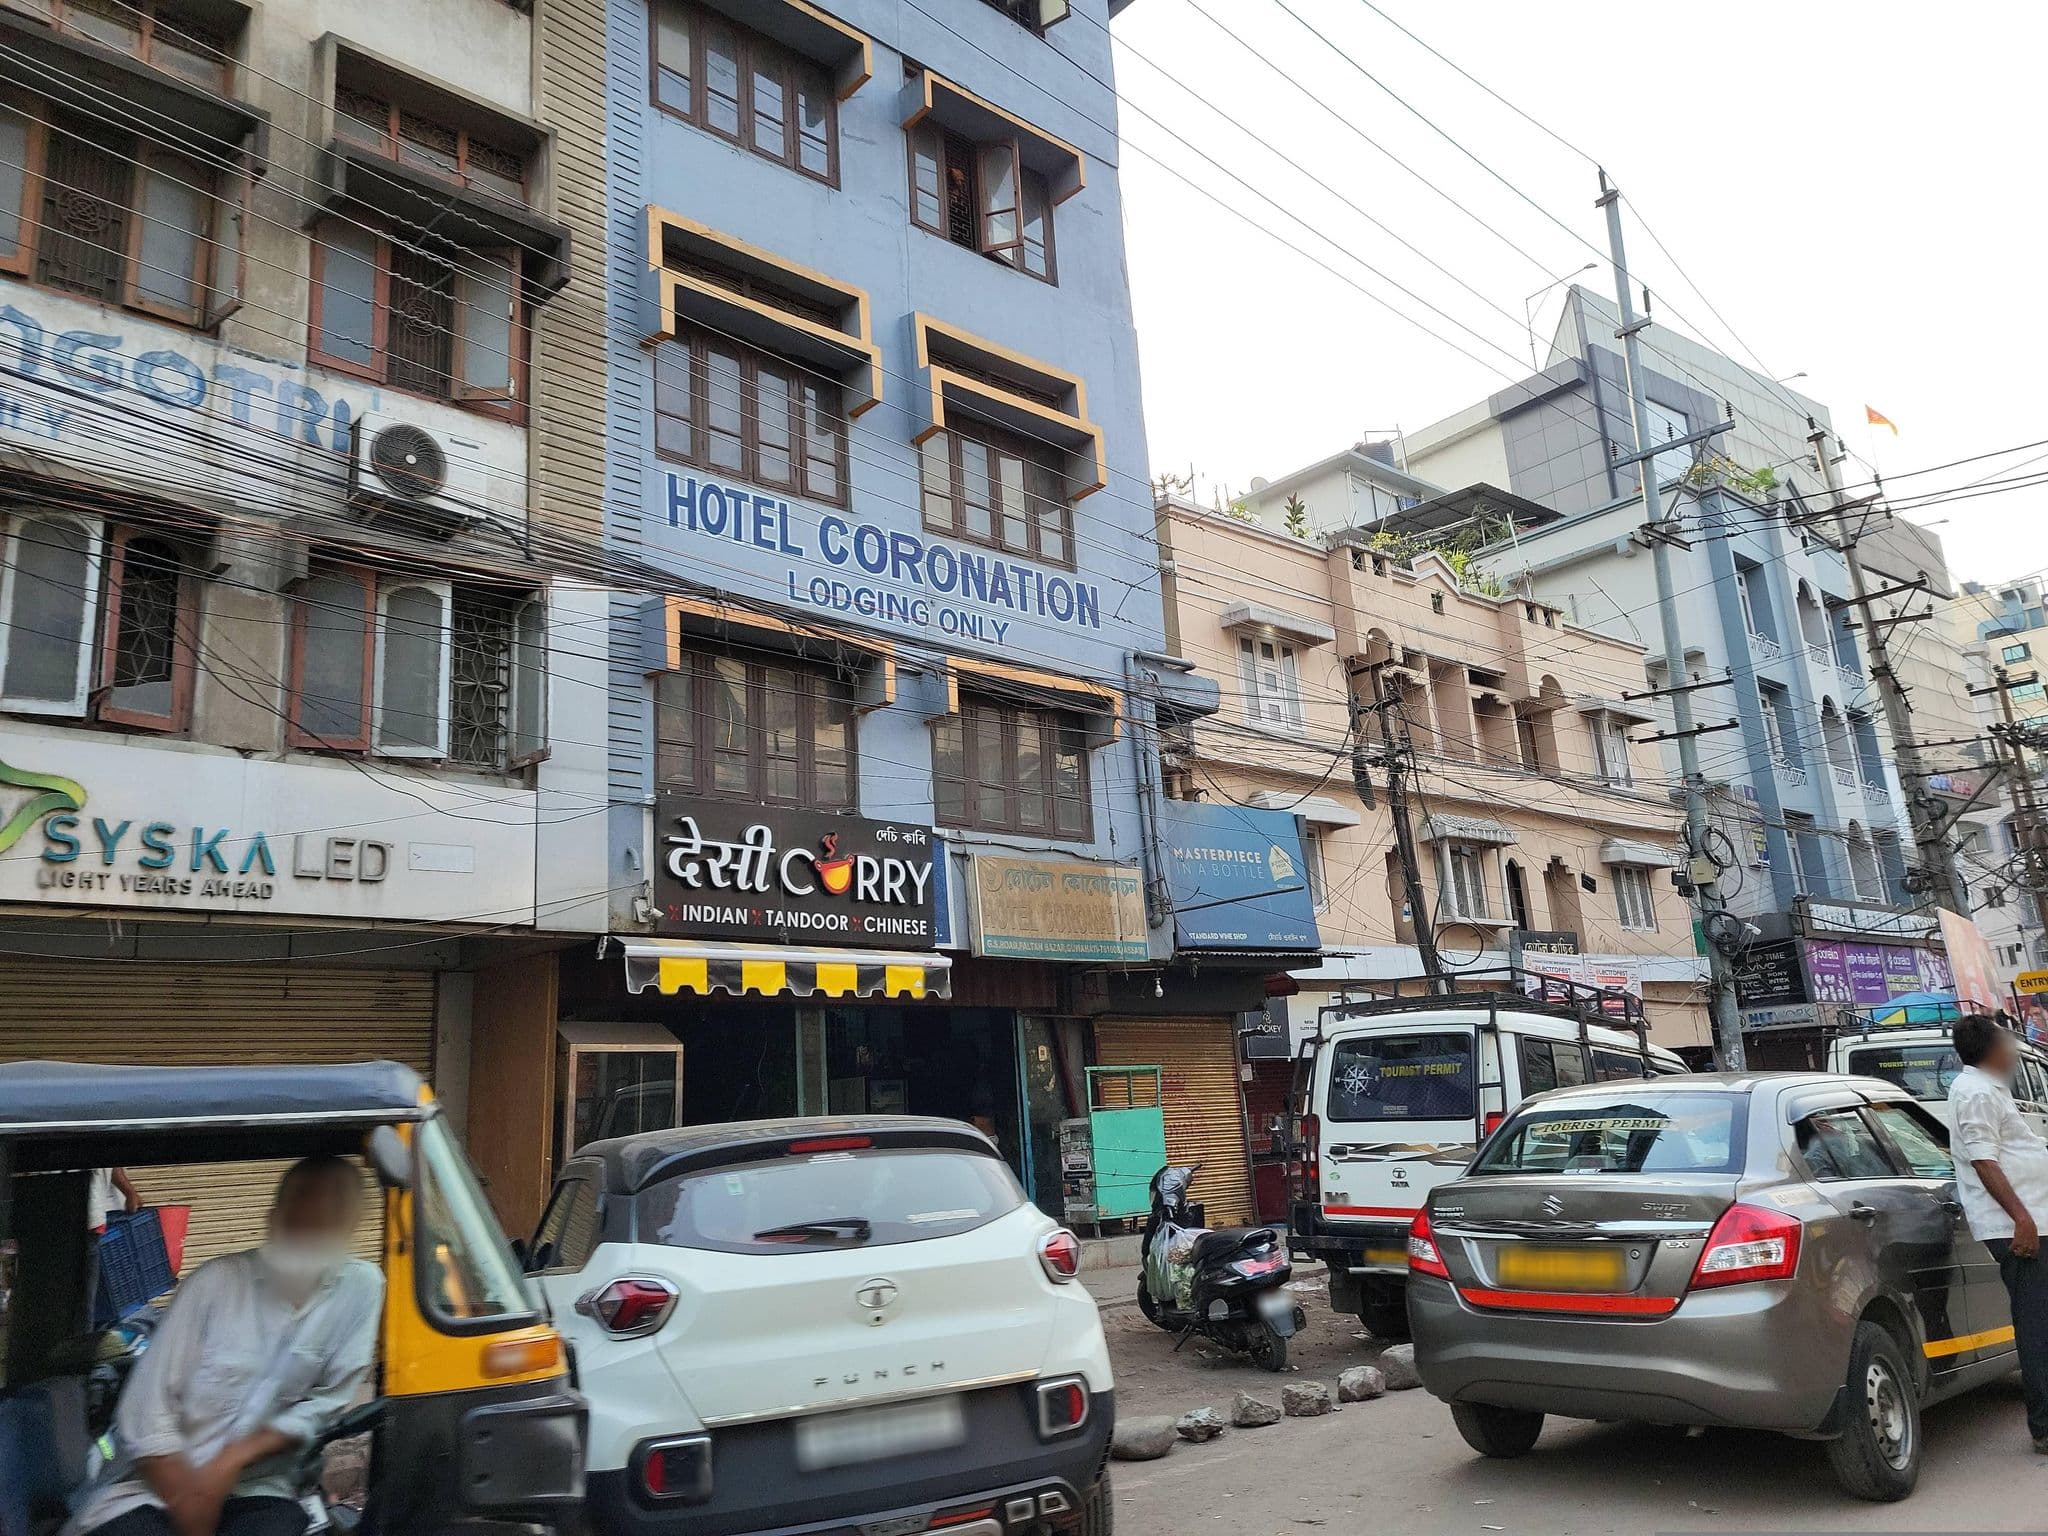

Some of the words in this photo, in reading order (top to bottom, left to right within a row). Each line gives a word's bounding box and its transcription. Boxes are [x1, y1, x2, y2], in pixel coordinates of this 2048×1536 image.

[666, 472, 804, 557] HOTEL
[818, 515, 1102, 630] CORONATION
[788, 569, 930, 628] LODGING
[938, 606, 1010, 646] ONLY
[294, 834, 392, 882] LED
[664, 815, 776, 893] देसी
[1173, 847, 1263, 864] MASTERPIECE
[1176, 862, 1192, 875] IN
[1199, 863, 1208, 877] A
[1213, 864, 1265, 880] BOTTLE
[37, 868, 109, 890] LIGHT
[120, 874, 192, 895] YEARS
[200, 878, 273, 899] AHEAD
[682, 904, 748, 926] INDIAN
[765, 908, 849, 932] TANDOOR
[863, 915, 928, 936] CHINESE
[1188, 932, 1219, 941] STANDARD
[1234, 933, 1248, 941] SHOP
[2020, 977, 2048, 988] ENTRY
[1256, 1024, 1282, 1033] OCKEY
[1379, 1064, 1421, 1079] TOURIST
[1423, 1062, 1462, 1076] PERMIT
[1879, 1061, 1908, 1069] TOURIST
[1908, 1059, 1936, 1068] PERMIT
[1542, 1120, 1608, 1133] TOURIST
[1640, 1202, 1692, 1212] SWIFT
[813, 1360, 945, 1388] PUNCH
